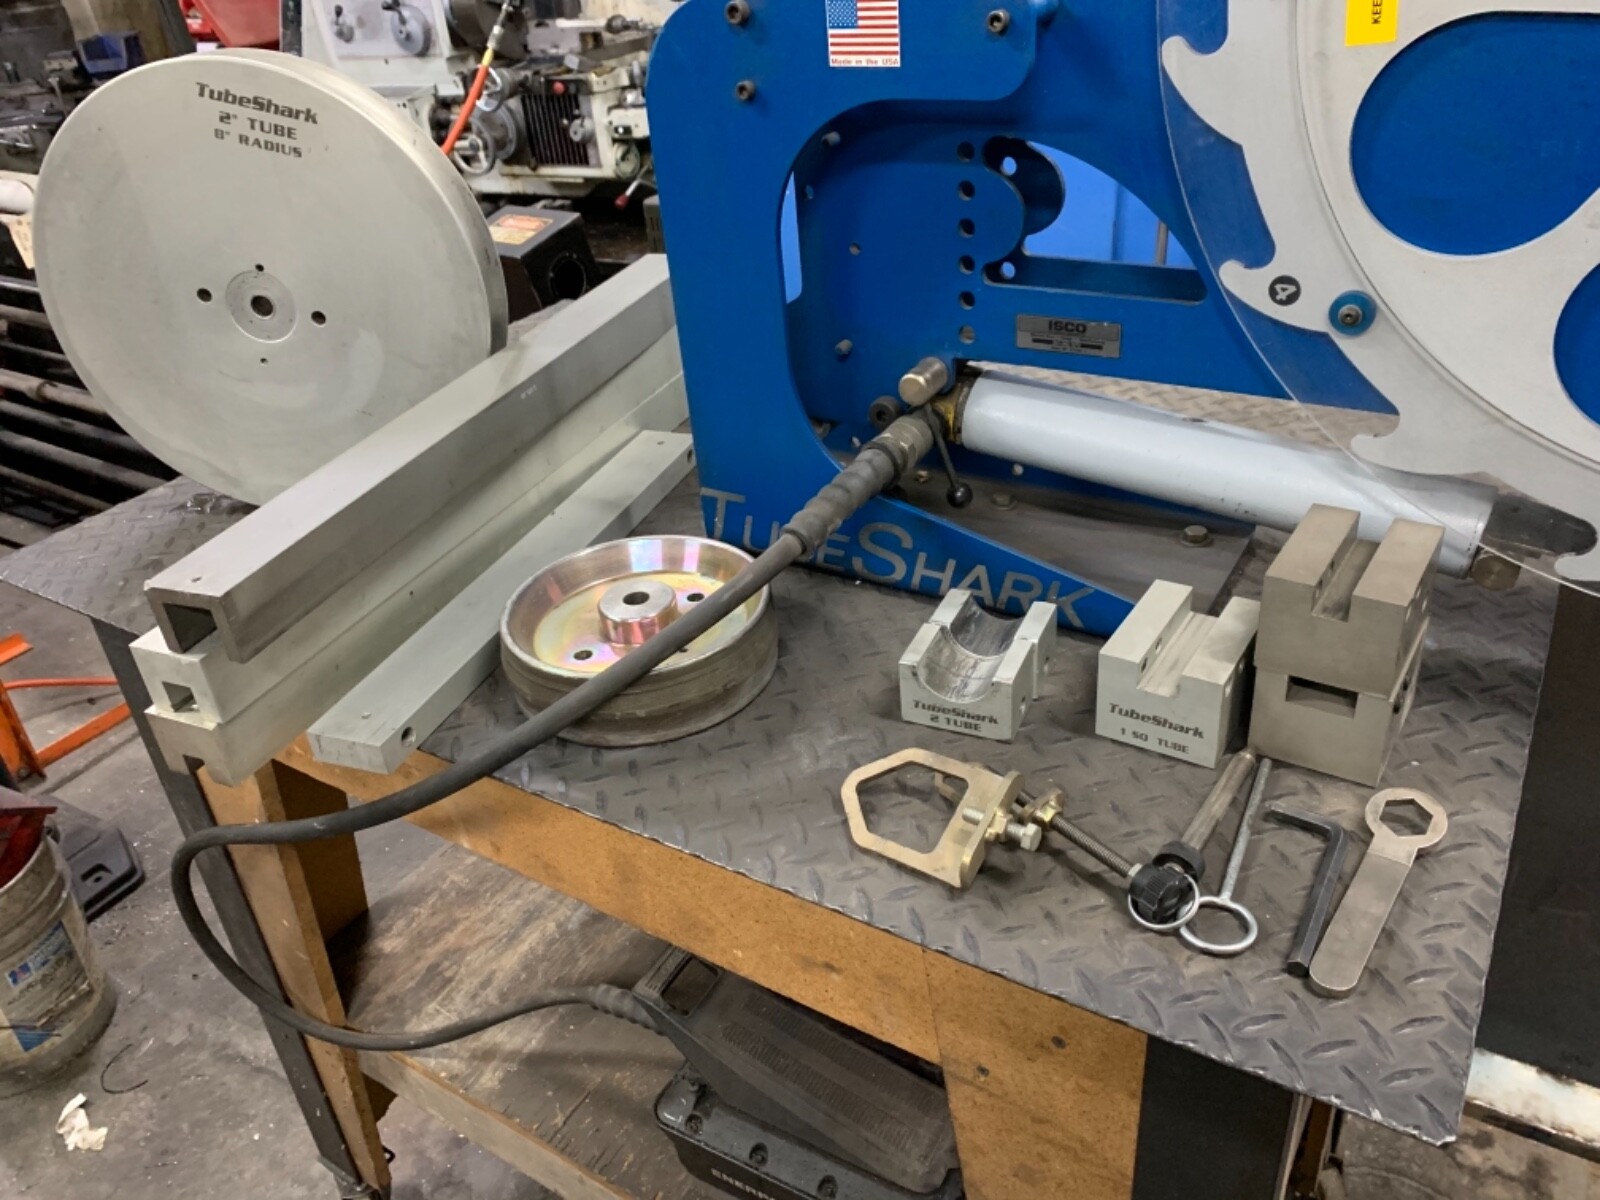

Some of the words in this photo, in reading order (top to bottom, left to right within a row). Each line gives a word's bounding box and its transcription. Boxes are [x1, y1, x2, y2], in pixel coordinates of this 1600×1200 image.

[882, 58, 899, 66] USA
[195, 81, 318, 125] TubeShark
[247, 116, 298, 141] TUBE
[238, 133, 303, 158] RADIUS
[1273, 283, 1298, 301] 4
[1048, 320, 1087, 334] ISCO
[912, 699, 999, 725] TubeShark
[929, 713, 940, 723] 2
[944, 716, 982, 733] TUBE
[1108, 702, 1205, 740] TubeShark
[1120, 727, 1127, 736] 1
[1156, 737, 1190, 755] TUBE
